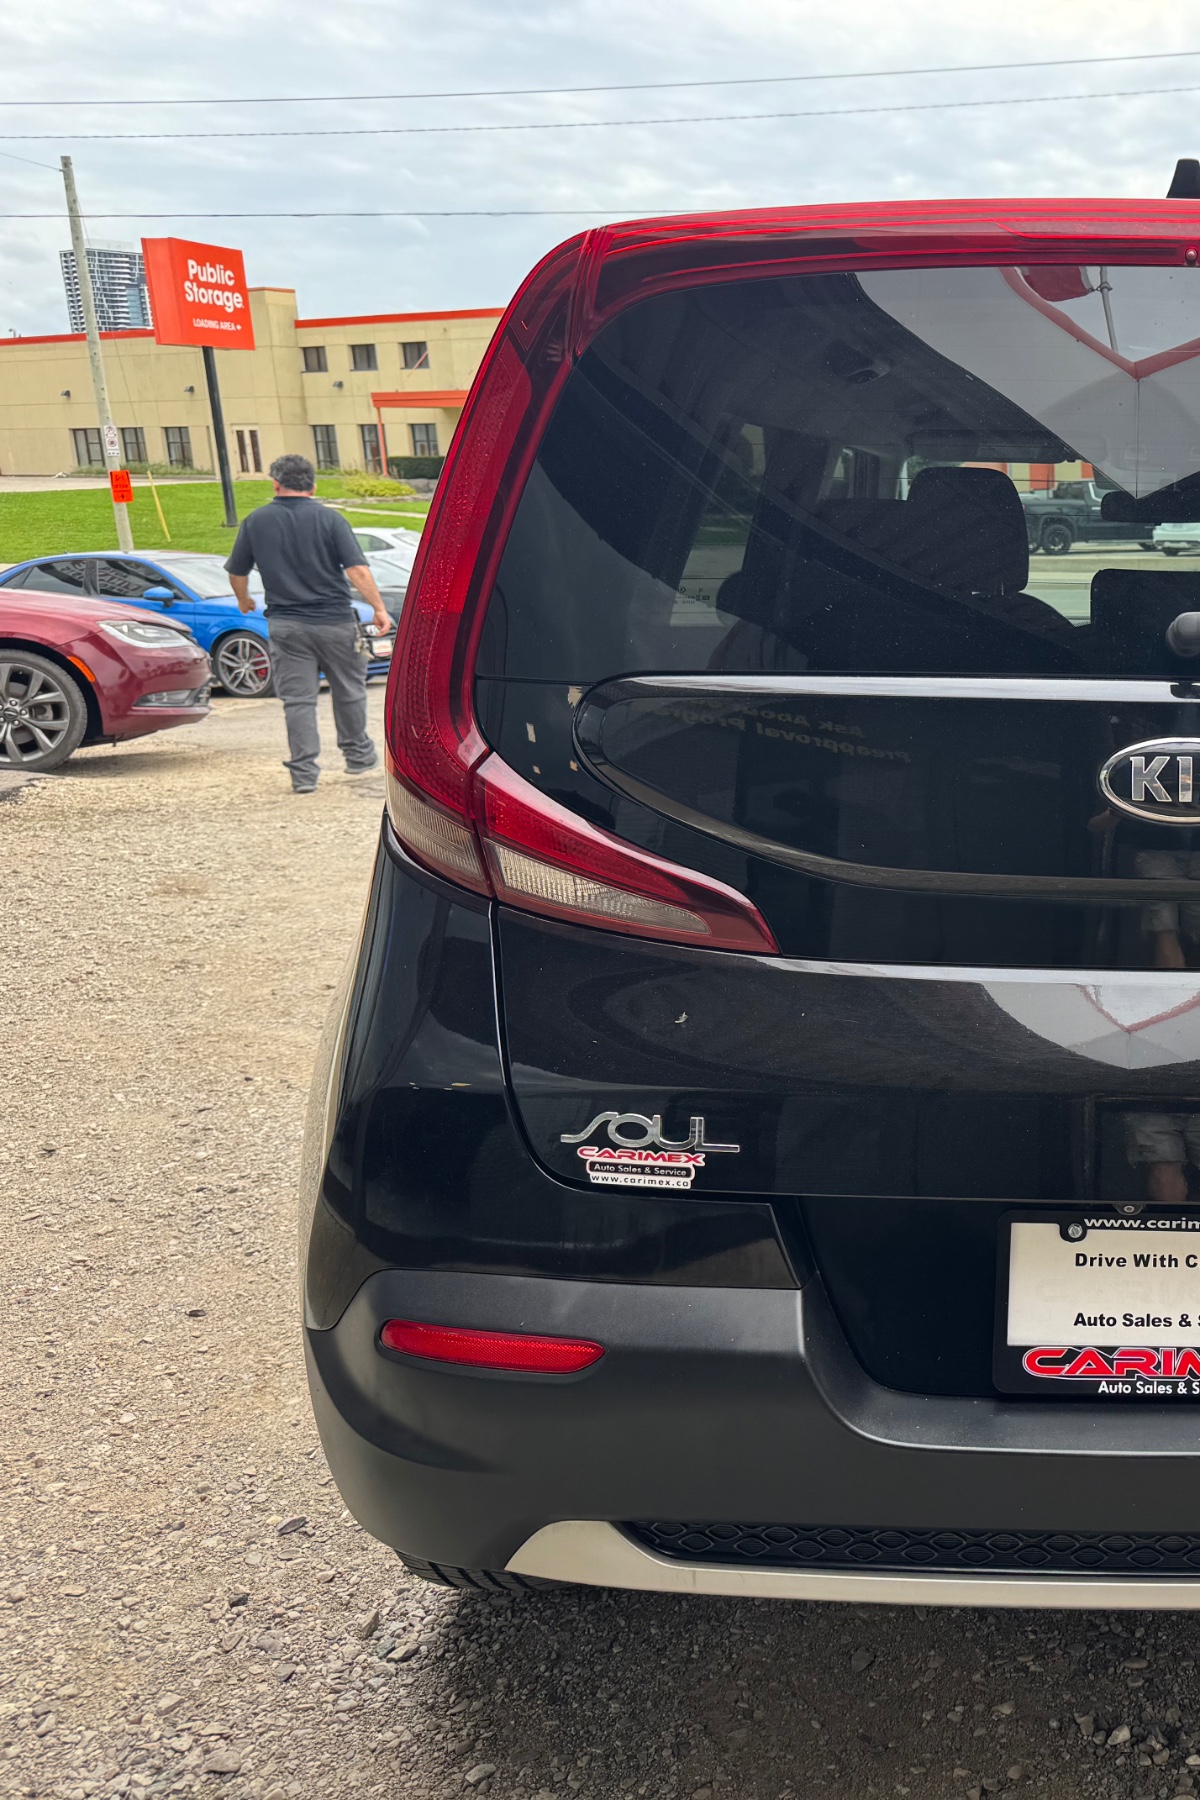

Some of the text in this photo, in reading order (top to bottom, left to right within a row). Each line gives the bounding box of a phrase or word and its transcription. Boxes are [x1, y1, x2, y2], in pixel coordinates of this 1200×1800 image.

[187, 259, 235, 286] Public
[193, 318, 237, 331] LOADING AREA
[560, 1111, 740, 1153] SOUL
[578, 1147, 705, 1166] CARIMEX
[594, 1163, 687, 1177] Auto Sales & Service
[591, 1174, 689, 1188] www.carimex.ca
[1075, 1253, 1127, 1268] Drive
[1133, 1253, 1179, 1268] With
[1073, 1312, 1118, 1327] Auto
[1122, 1313, 1173, 1328] Sales
[1178, 1314, 1193, 1328] &
[1098, 1381, 1132, 1395] Auto
[1136, 1381, 1173, 1395] Sales
[1177, 1382, 1188, 1395] &
